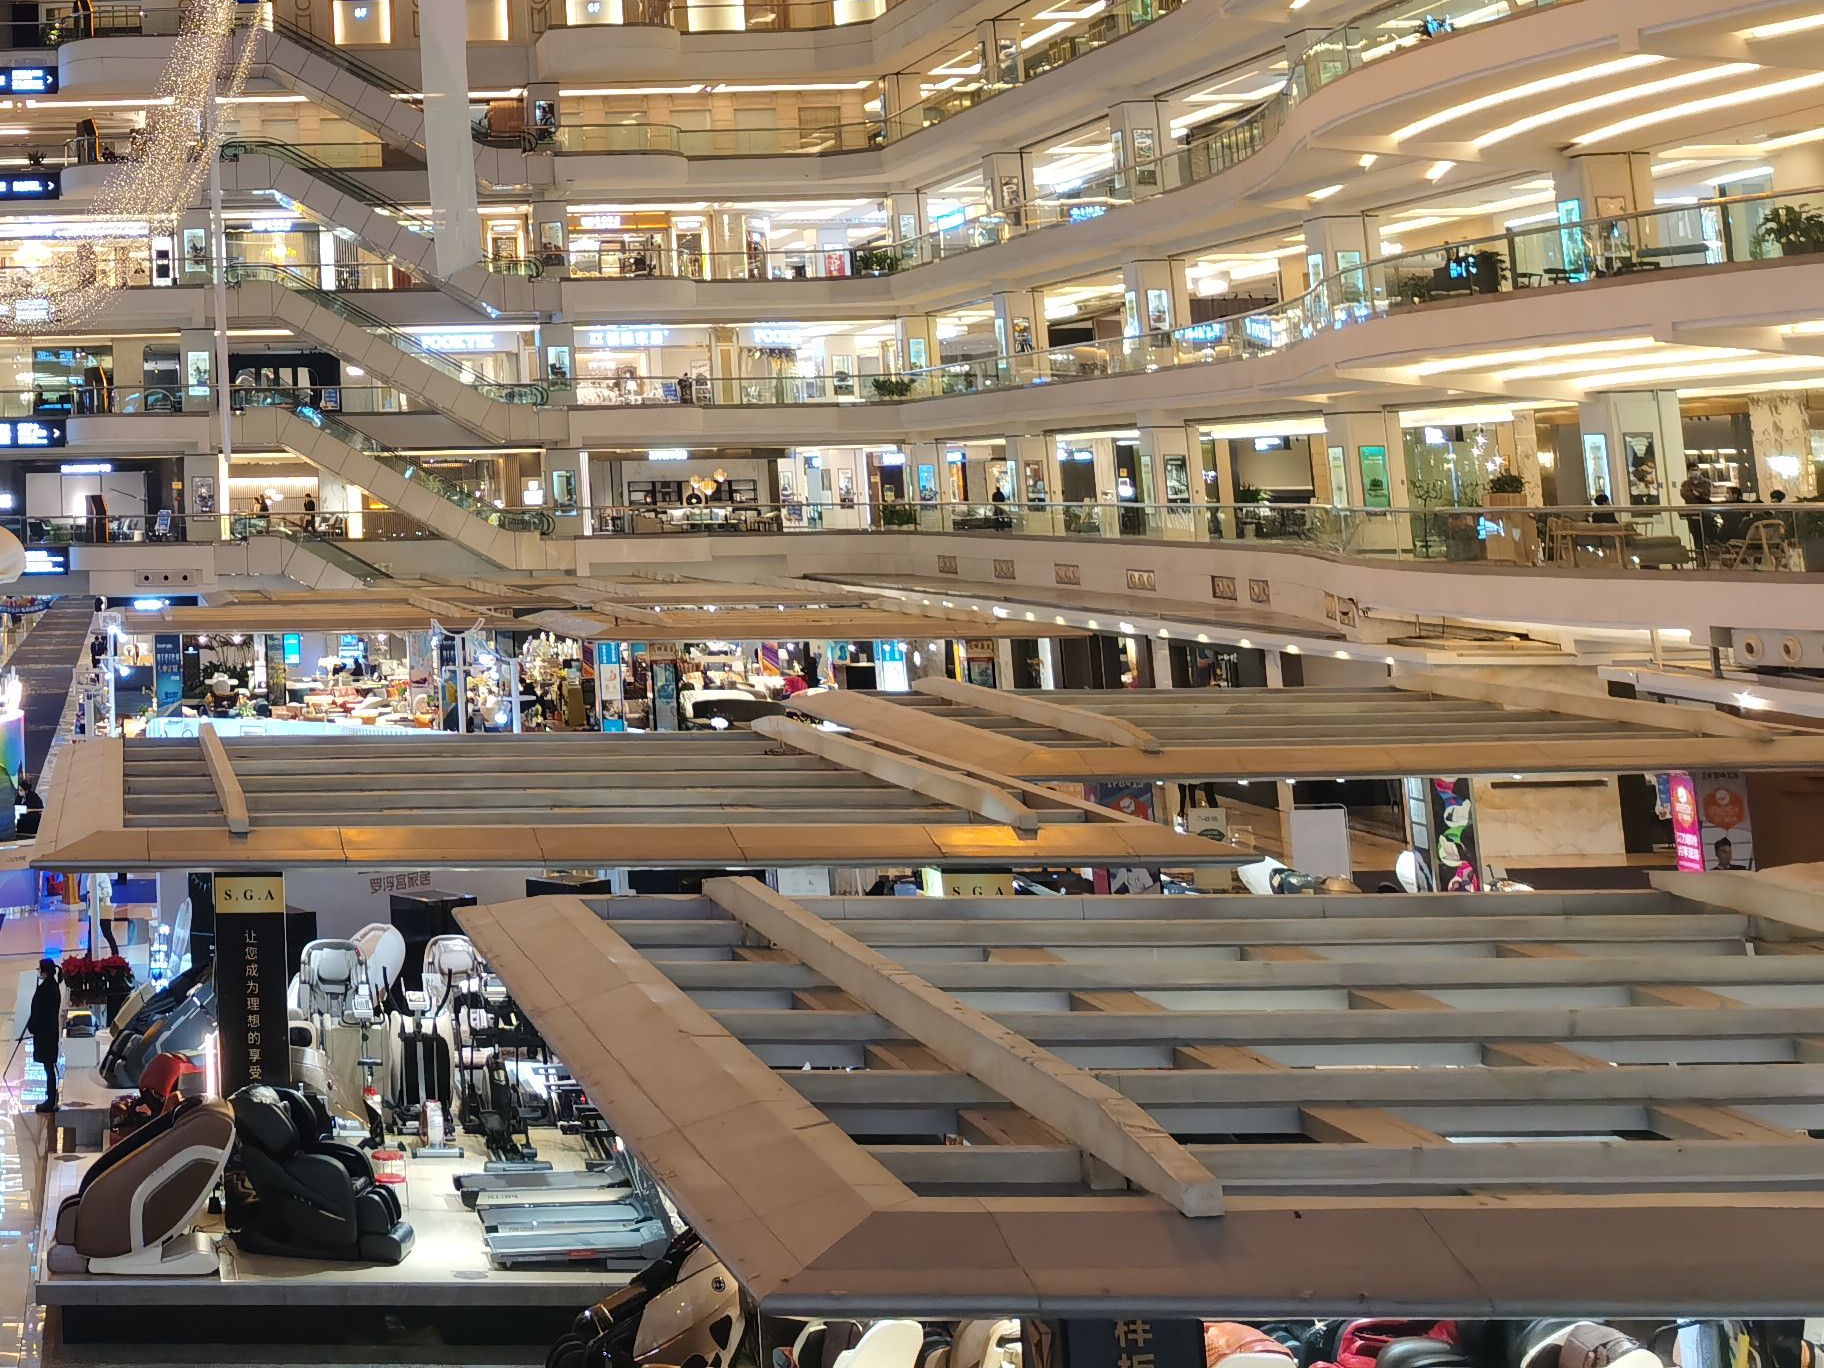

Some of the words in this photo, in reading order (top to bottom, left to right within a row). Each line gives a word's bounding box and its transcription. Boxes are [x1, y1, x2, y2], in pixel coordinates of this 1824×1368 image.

[369, 871, 431, 894] 罗浮宫家居
[224, 888, 275, 901] S.G.A
[245, 929, 262, 1081] 让您成为理想的享受
